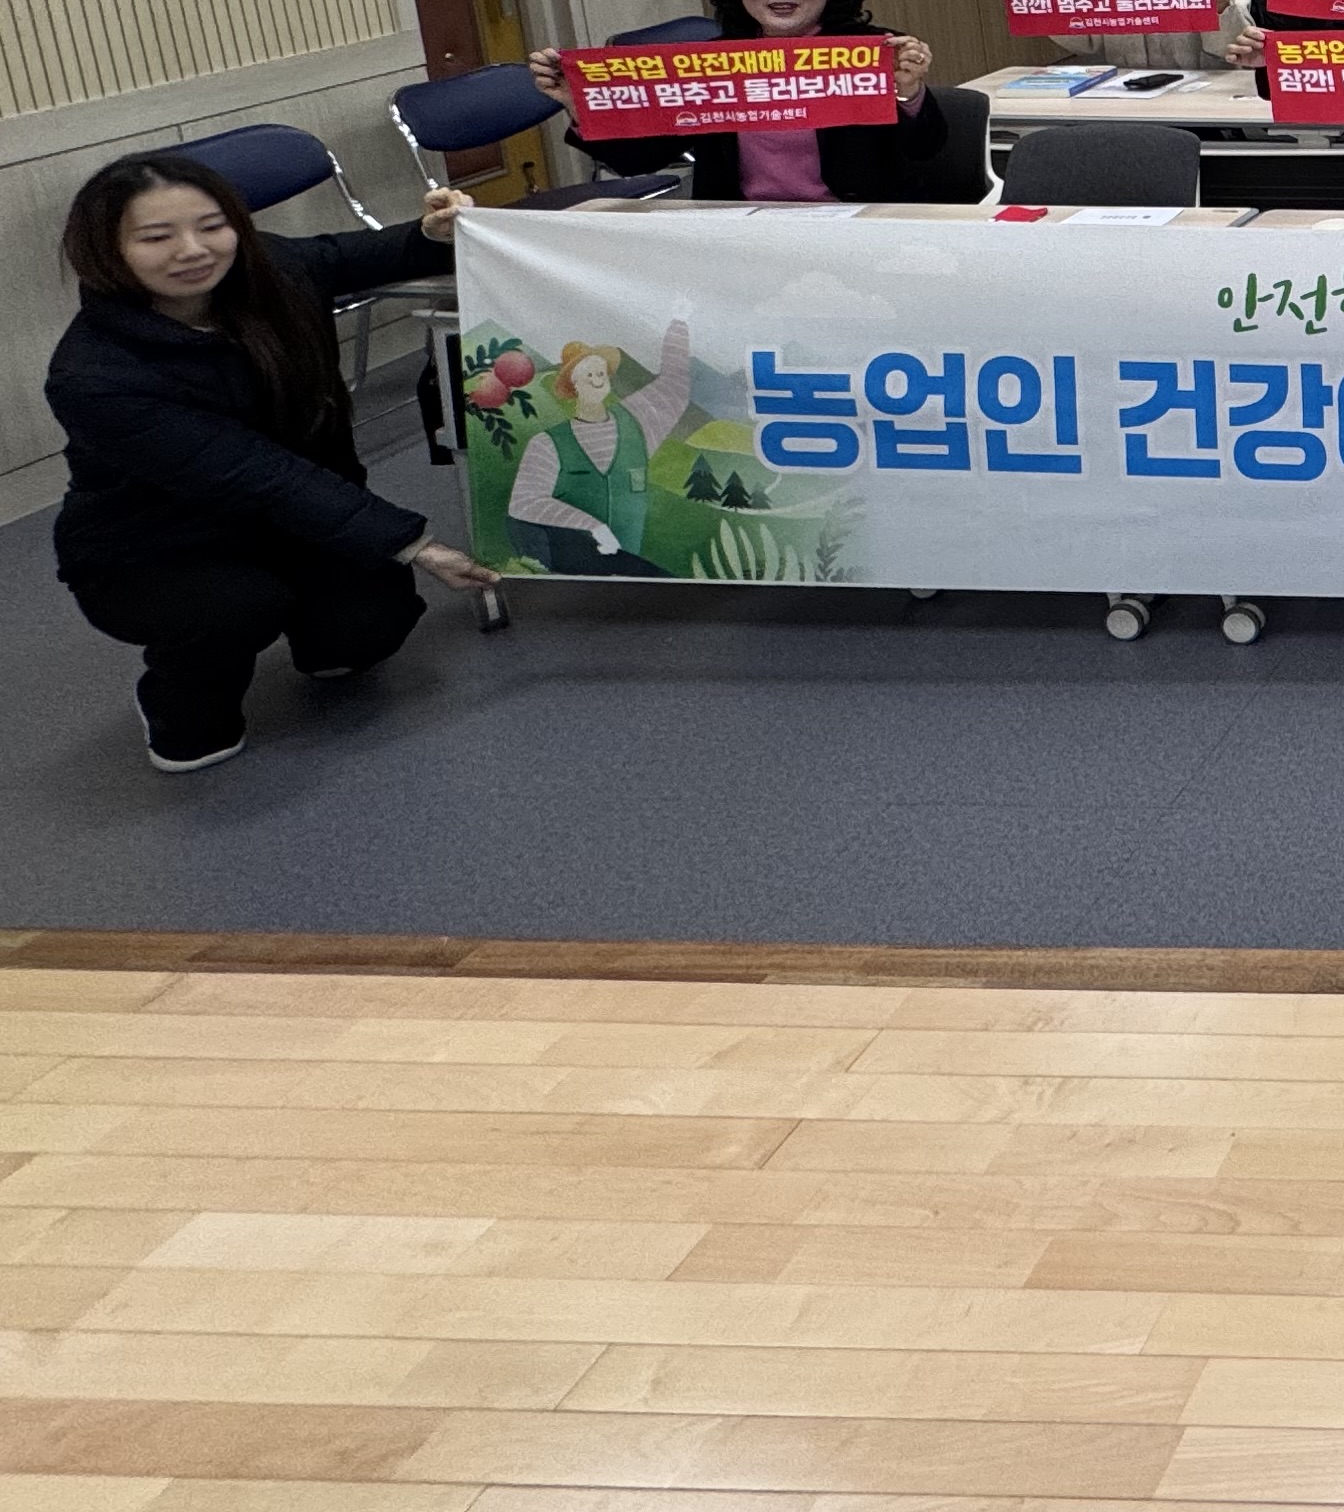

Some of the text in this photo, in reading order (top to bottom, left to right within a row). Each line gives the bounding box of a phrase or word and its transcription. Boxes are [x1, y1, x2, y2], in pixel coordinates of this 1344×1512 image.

[577, 47, 880, 82] 농작업 안전재해 ZERO!
[1278, 69, 1334, 93] 잠깐!
[583, 73, 887, 111] 잠깐! 멈추고 둘러보세요!
[751, 350, 1083, 475] 농업인
